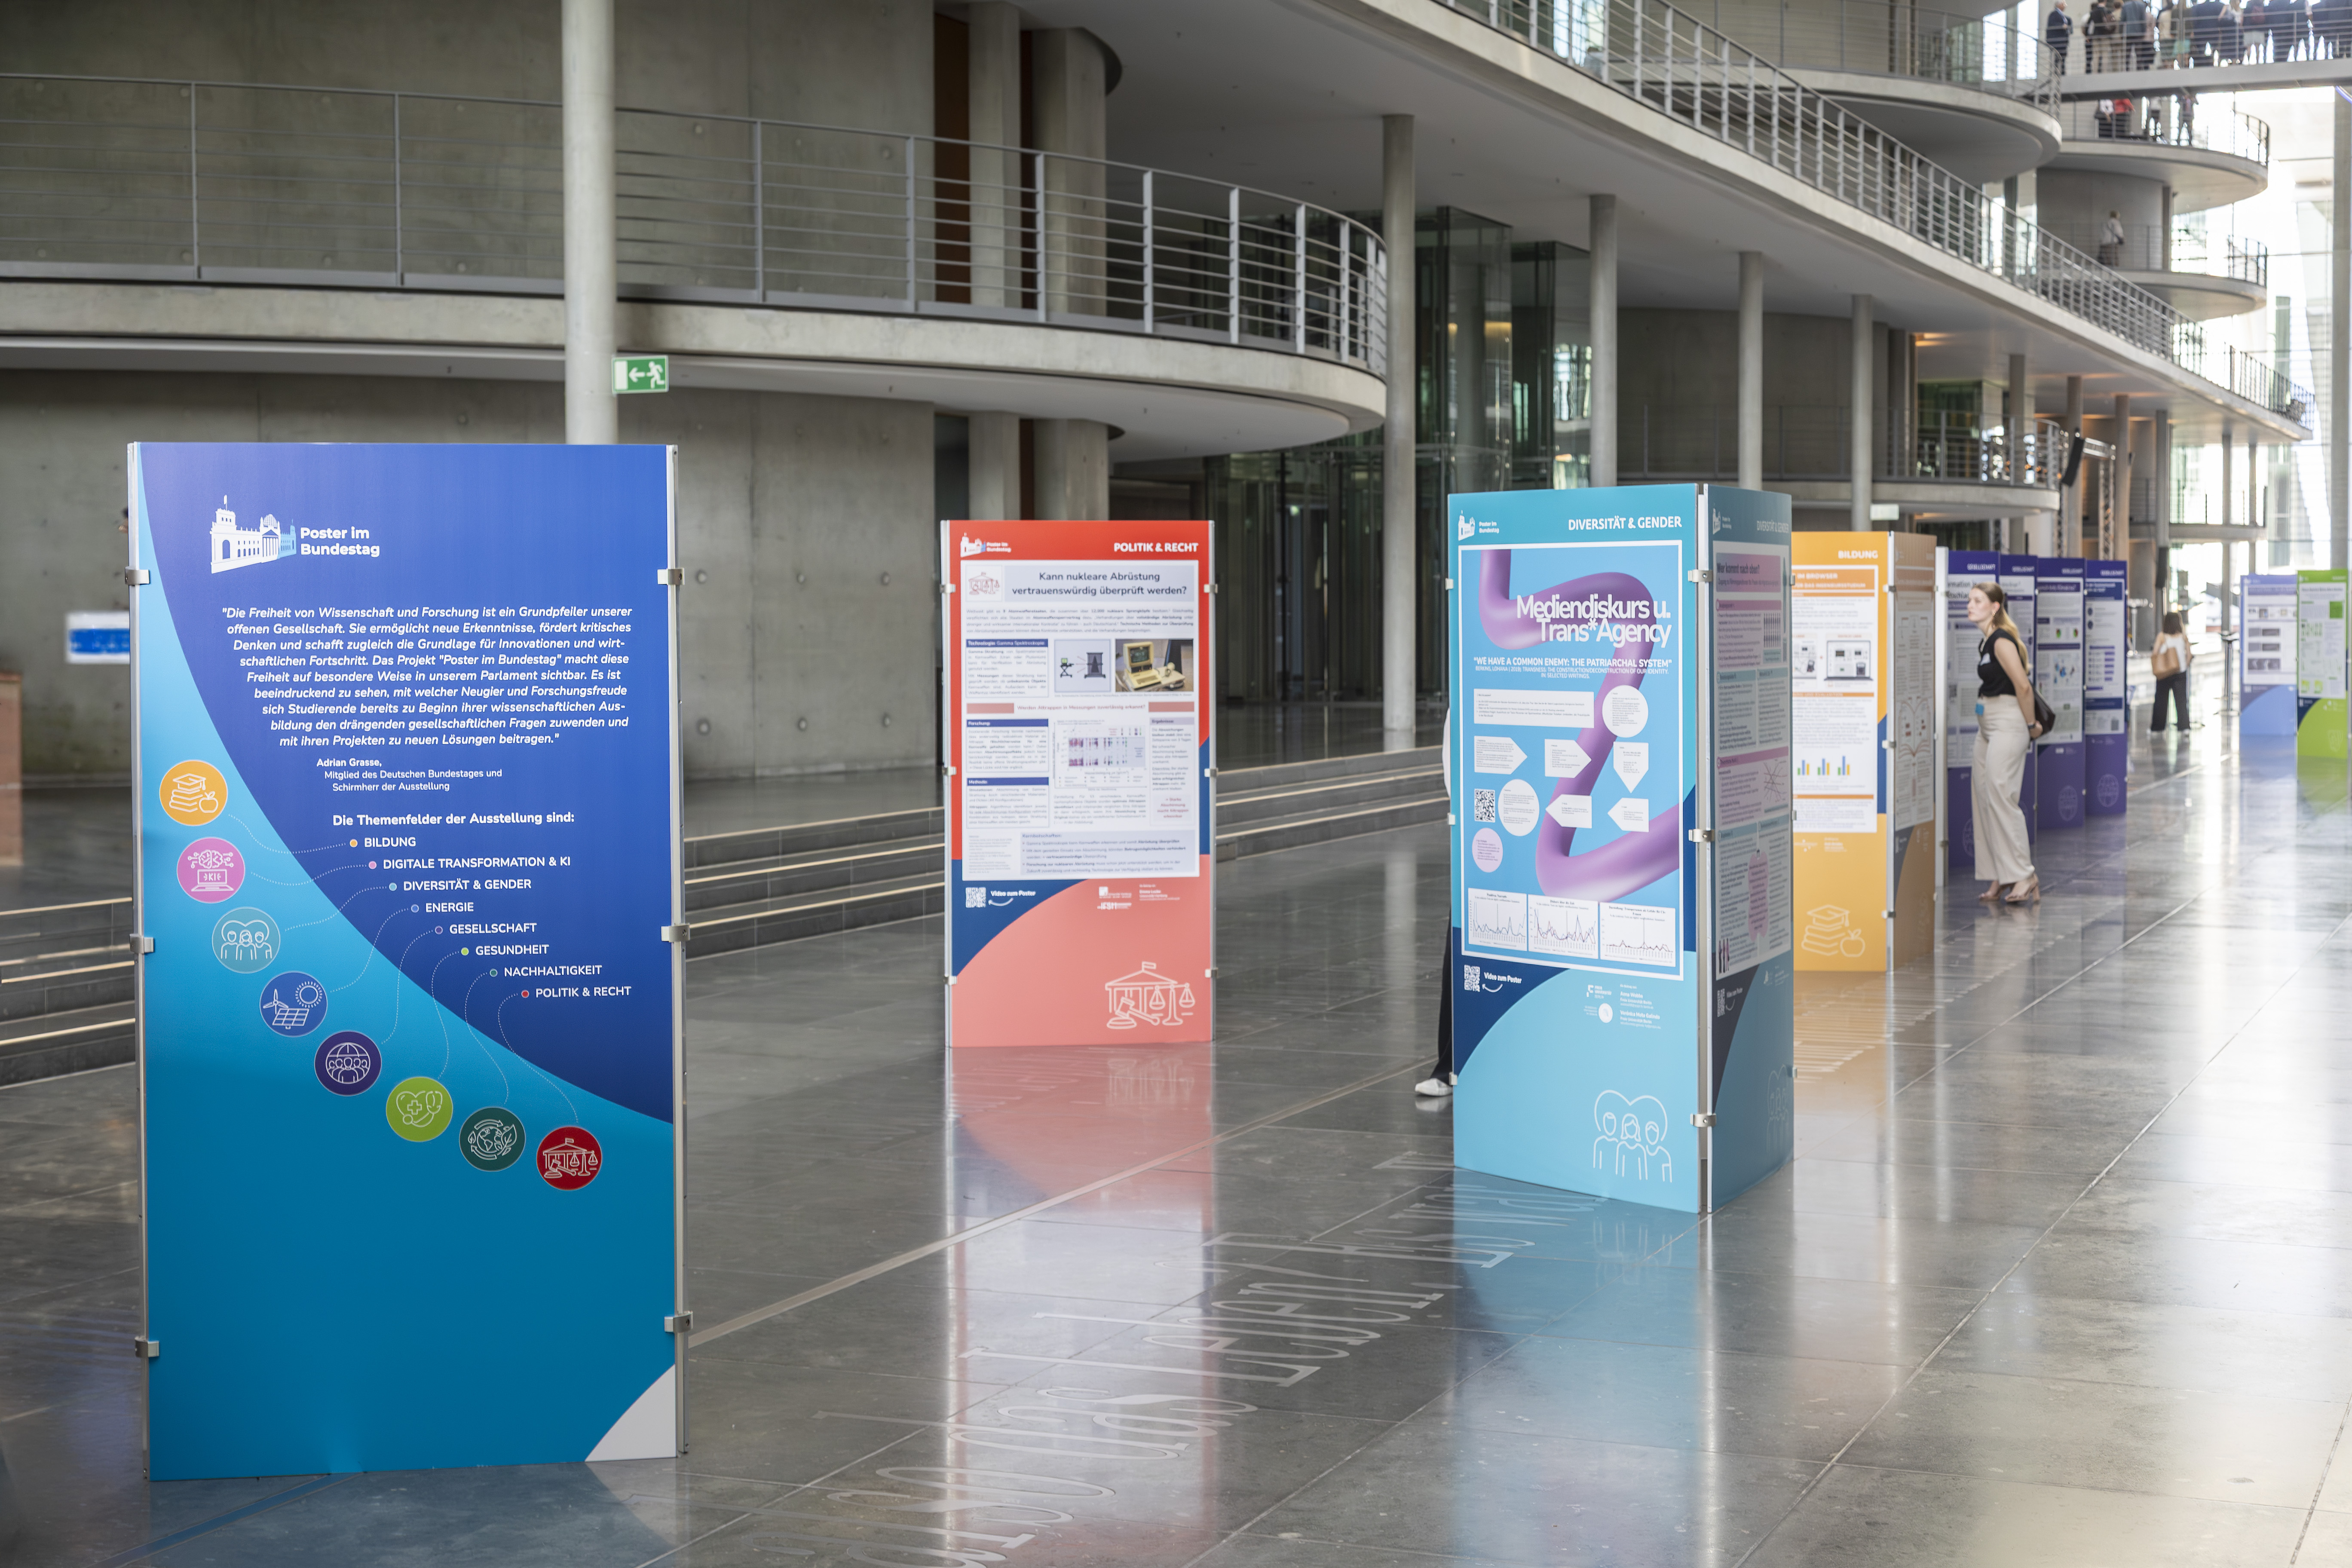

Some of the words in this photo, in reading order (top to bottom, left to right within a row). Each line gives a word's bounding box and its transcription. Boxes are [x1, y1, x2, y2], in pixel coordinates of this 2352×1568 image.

[1569, 515, 1626, 530] DIVERSITÄT
[1628, 518, 1636, 529] &
[1638, 516, 1682, 528] GENDER
[300, 527, 348, 539] Poster
[351, 526, 370, 539] im
[300, 543, 380, 557] Bundestag
[1114, 542, 1154, 552] POLITIK
[1155, 542, 1163, 552] &
[1164, 542, 1199, 552] RECHT
[1838, 550, 1878, 559] BILDUNG
[1039, 573, 1063, 581] Kann
[1066, 572, 1107, 581] nukleare
[1110, 572, 1160, 582] Abrüstung
[1012, 586, 1096, 596] vertrauenswürdig
[1100, 586, 1144, 596] überprüft
[1147, 586, 1187, 594] werden?
[222, 607, 246, 619] "Die
[248, 607, 292, 619] Freiheit
[294, 609, 315, 618] von
[318, 606, 395, 618] Wissenschaft
[397, 606, 419, 618] und
[421, 606, 479, 619] Forschung
[482, 606, 496, 617] ist
[499, 606, 515, 617] ein
[518, 606, 588, 619] Grundpfeiler
[591, 608, 633, 616] unserer
[1517, 594, 1650, 619] Mediendiskurs
[1654, 601, 1671, 619] u.
[227, 623, 270, 634] offenen
[273, 623, 345, 634] Gesellschaft.
[349, 622, 367, 634] Sie
[369, 622, 430, 636] ermöglicht
[432, 625, 459, 633] neue
[462, 622, 536, 634] Erkenntnisse,
[539, 622, 578, 633] fördert
[579, 622, 631, 632] kritisches
[233, 639, 276, 651] Denken
[280, 639, 302, 650] und
[305, 639, 344, 650] schafft
[346, 638, 393, 652] zugleich
[396, 638, 414, 649] die
[417, 638, 476, 651] Grundlage
[479, 638, 496, 649] für
[499, 637, 570, 649] Innovationen
[573, 637, 595, 649] und
[598, 637, 625, 648] wirt-
[240, 655, 306, 667] schaftlichen
[309, 655, 369, 666] Fortschritt.
[372, 655, 394, 666] Das
[397, 654, 436, 668] Projekt
[439, 654, 479, 665] "Poster
[481, 654, 495, 665] im
[498, 653, 562, 667] Bundestag"
[564, 653, 599, 665] macht
[600, 653, 629, 664] diese
[1488, 657, 1505, 665] HAVE
[1507, 657, 1511, 665] A
[1513, 657, 1543, 665] COMMON
[1545, 658, 1570, 666] ENEMY:
[1571, 658, 1585, 666] THE
[1586, 658, 1637, 667] PATRIARCHAL
[247, 671, 290, 683] Freiheit
[292, 671, 312, 683] auf
[314, 671, 374, 682] besondere
[377, 671, 412, 682] Weise
[415, 671, 426, 681] in
[429, 672, 477, 681] unserem
[480, 669, 538, 681] Parlament
[541, 669, 587, 680] sichtbar.
[591, 669, 604, 680] Es
[607, 669, 622, 680] ist
[254, 687, 336, 698] beeindruckend
[338, 689, 352, 698] zu
[354, 687, 390, 698] sehen,
[393, 686, 412, 697] mit
[414, 686, 459, 697] welcher
[461, 686, 505, 699] Neugier
[507, 685, 529, 697] und
[531, 685, 628, 698] Forschungsfreude
[262, 703, 285, 715] sich
[288, 703, 357, 714] Studierende
[360, 703, 399, 714] bereits
[402, 704, 416, 713] zu
[419, 702, 458, 715] Beginn
[461, 701, 488, 713] ihrer
[491, 701, 596, 713] wissenschaftlichen
[598, 701, 626, 711] Aus-
[270, 720, 313, 732] bildung
[315, 719, 337, 730] den
[339, 719, 405, 732] drängenden
[408, 717, 506, 731] gesellschaftlichen
[509, 717, 546, 730] Fragen
[549, 717, 605, 728] zuwenden
[608, 716, 629, 727] und
[279, 735, 298, 747] mit
[300, 735, 329, 746] ihren
[332, 735, 385, 748] Projekten
[388, 737, 401, 745] zu
[404, 736, 438, 745] neuen
[442, 734, 496, 746] Lösungen
[499, 732, 560, 746] beitragen."
[316, 758, 346, 767] Adrian
[349, 757, 382, 767] Grasse,
[324, 770, 359, 781] Mitglied
[361, 770, 377, 779] des
[380, 769, 426, 779] Deutschen
[428, 769, 484, 779] Bundestages
[486, 769, 502, 777] und
[332, 782, 380, 792] Schirmherr
[381, 782, 396, 791] der
[398, 781, 450, 792] Ausstellung
[333, 814, 353, 826] Die
[356, 813, 442, 826] Themenfelder
[445, 813, 466, 824] der
[469, 812, 542, 825] Ausstellung
[546, 811, 574, 823] sind:
[364, 836, 416, 848] BILDUNG
[383, 858, 435, 870] DIGITALE
[438, 856, 545, 868] TRANSFORMATION
[548, 856, 557, 867] &
[560, 856, 570, 867] KI
[208, 873, 216, 881] KI
[403, 877, 470, 891] DIVERSITÄT
[473, 879, 481, 890] &
[484, 879, 532, 890] GENDER
[425, 902, 474, 913] ENERGIE
[449, 922, 537, 934] GESELLSCHAFT
[475, 944, 549, 956] GESUNDHEIT
[504, 965, 603, 977] NACHHALTIGKEIT
[1484, 972, 1497, 980] Video
[1507, 975, 1522, 983] Poster
[536, 987, 579, 998] POLITIK
[582, 987, 591, 997] &
[594, 986, 632, 997] RECHT
[1200, 1229, 1536, 1268] Es
[956, 1260, 1463, 1387] Leben?
[810, 1387, 1258, 1461] das
